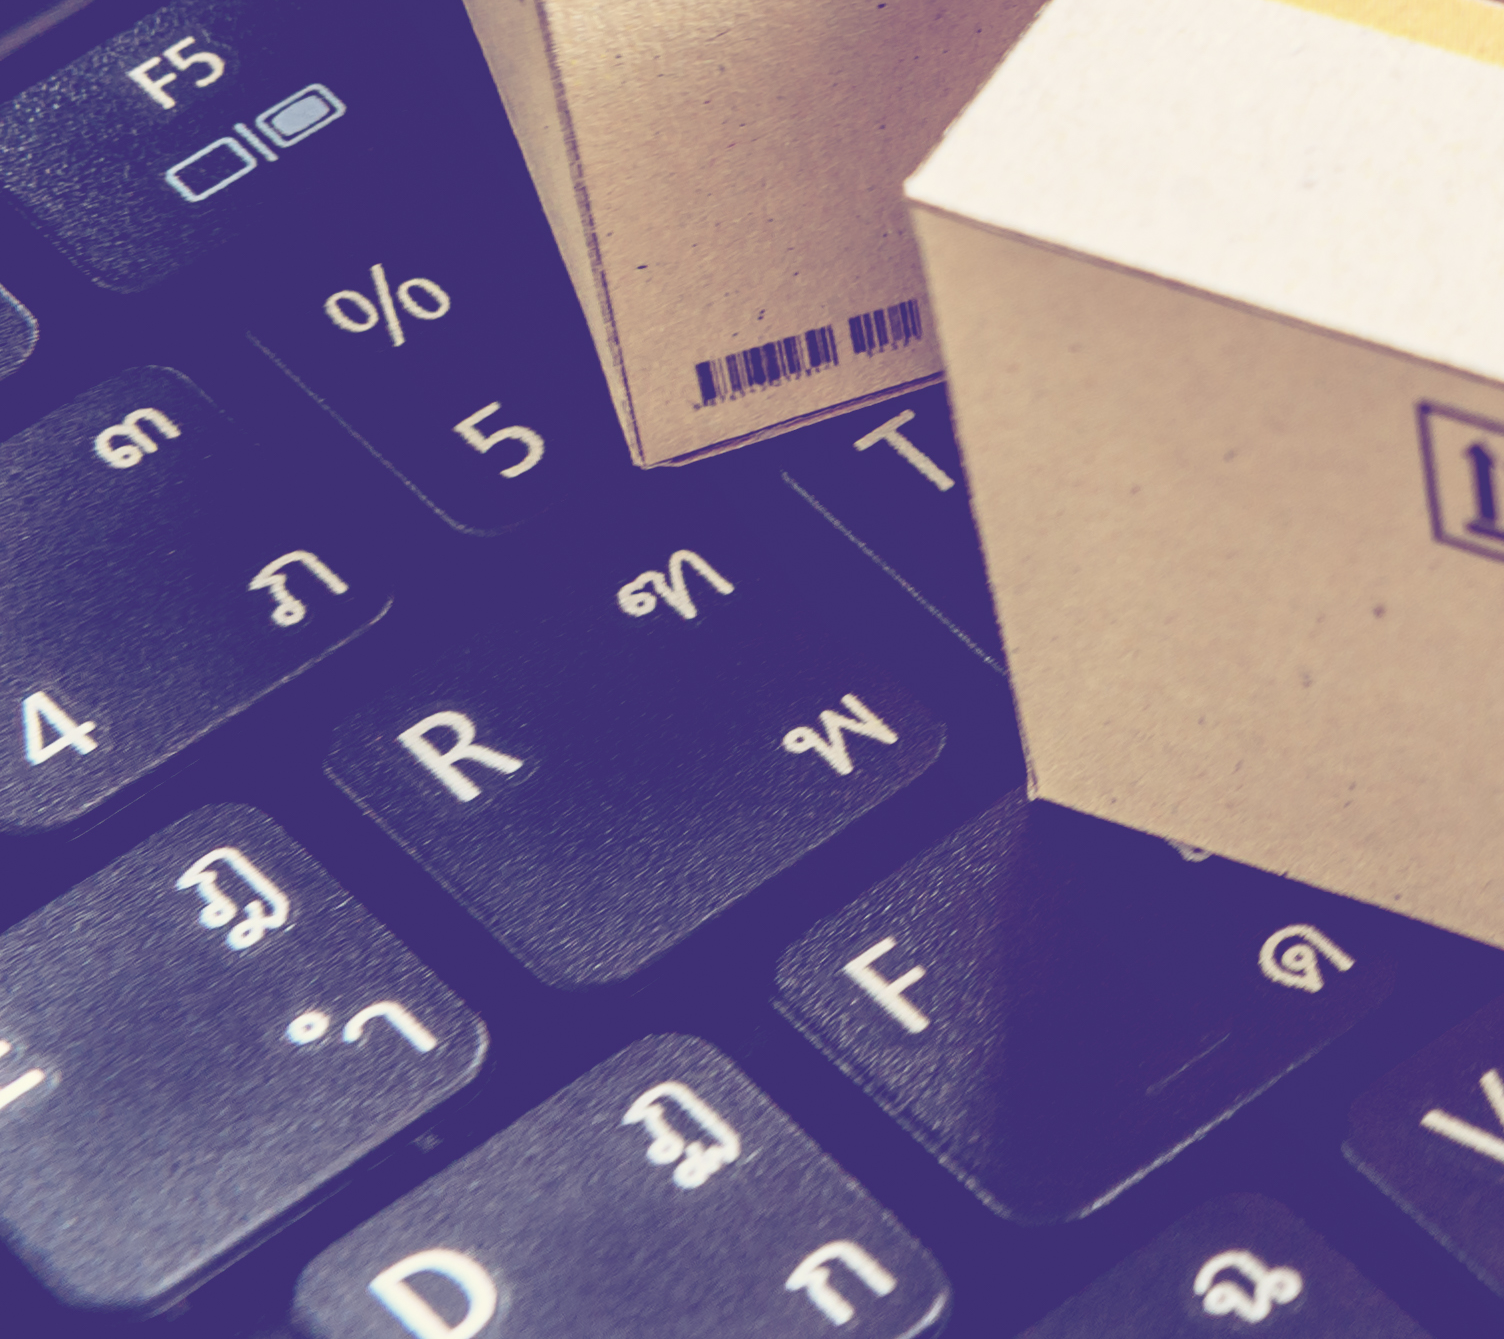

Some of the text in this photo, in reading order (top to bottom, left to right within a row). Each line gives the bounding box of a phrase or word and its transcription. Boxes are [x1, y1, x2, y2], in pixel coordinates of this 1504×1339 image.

[126, 37, 224, 109] F5
[325, 264, 450, 346] %
[454, 402, 544, 478] 5
[852, 408, 957, 493] T
[23, 691, 97, 765] 4
[397, 711, 522, 802] R
[842, 937, 929, 1033] F
[370, 1249, 497, 1339] D
[785, 1241, 895, 1325] ก
